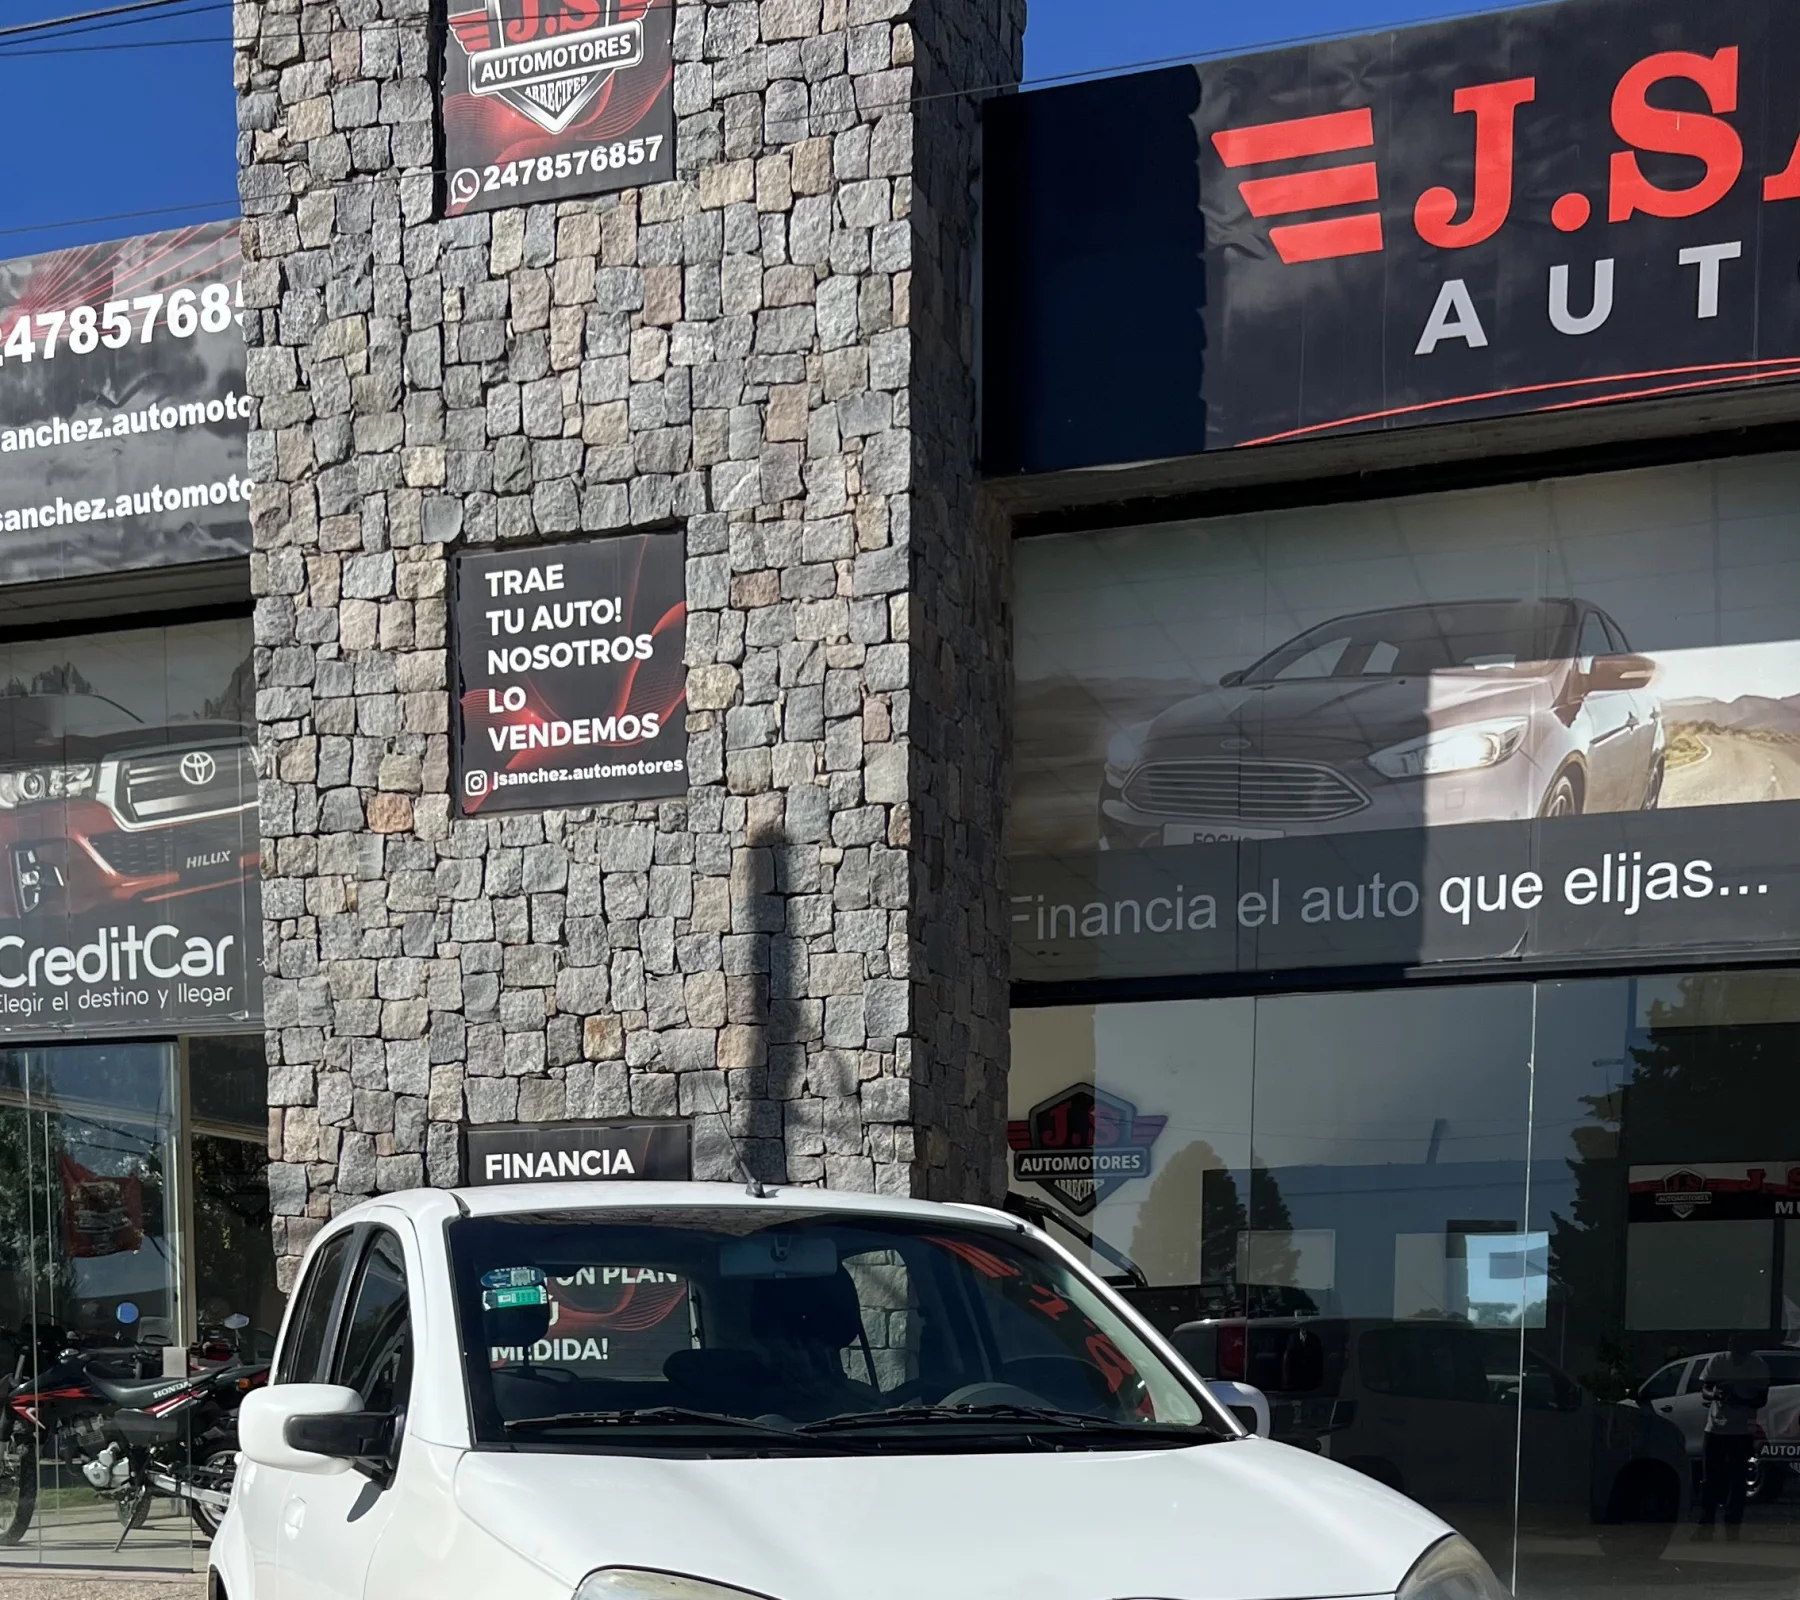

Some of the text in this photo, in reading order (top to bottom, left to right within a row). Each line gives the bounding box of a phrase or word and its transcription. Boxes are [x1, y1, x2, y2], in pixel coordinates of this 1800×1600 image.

[480, 34, 632, 83] AUTOMOTORES
[525, 75, 588, 113] ARRECIFES
[483, 135, 663, 192] 2478576857
[1414, 45, 1800, 249] J.S
[1414, 240, 1742, 355] AUT
[0, 278, 245, 367] 4785768
[0, 473, 256, 532] anchez.automoto
[485, 563, 565, 597] TRAE
[485, 597, 623, 636] TU AUTO!
[487, 633, 654, 676] NOSOTROS
[488, 686, 527, 714] LO
[487, 712, 661, 752] VENDEMOS
[491, 758, 684, 790] jsanchez.automotores
[186, 850, 231, 869] HILUX
[1236, 878, 1280, 928] el
[1300, 872, 1420, 924] auto
[1439, 871, 1544, 926] que
[1563, 850, 1769, 916] elijas...
[0, 924, 234, 989] CreditCar
[52, 991, 69, 1012] el
[78, 986, 149, 1010] destino
[157, 988, 169, 1010] y
[178, 982, 234, 1008] llegar
[1041, 1100, 1121, 1149] J.S
[485, 1149, 636, 1180] FINANCIA
[1020, 1154, 1142, 1173] AUTOMOTORES
[153, 1381, 189, 1399] HONDA
